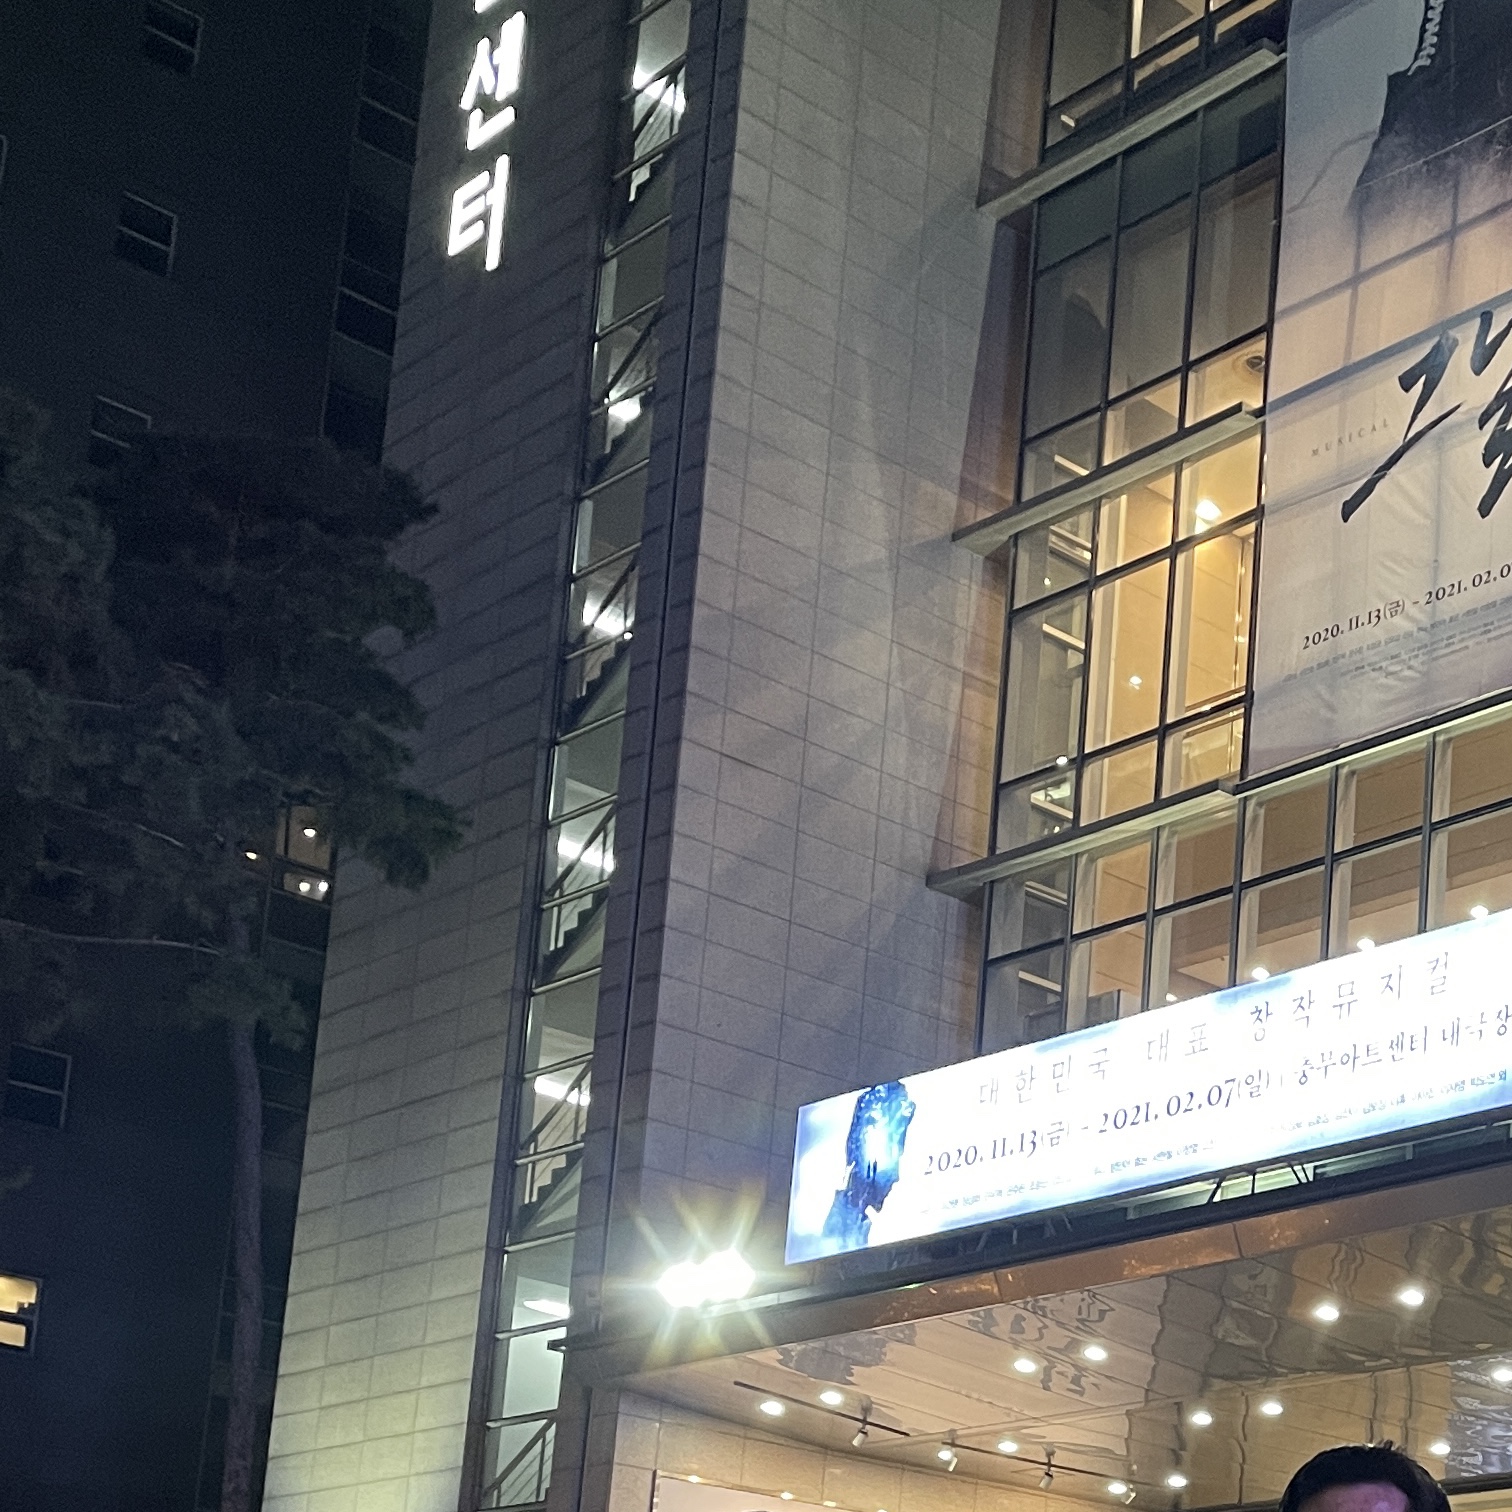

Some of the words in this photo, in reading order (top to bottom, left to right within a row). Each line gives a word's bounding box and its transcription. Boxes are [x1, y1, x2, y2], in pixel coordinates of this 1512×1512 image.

[447, 0, 527, 272] 센터
[979, 1047, 1111, 1105] 대한민국
[1146, 1023, 1209, 1062] 대표
